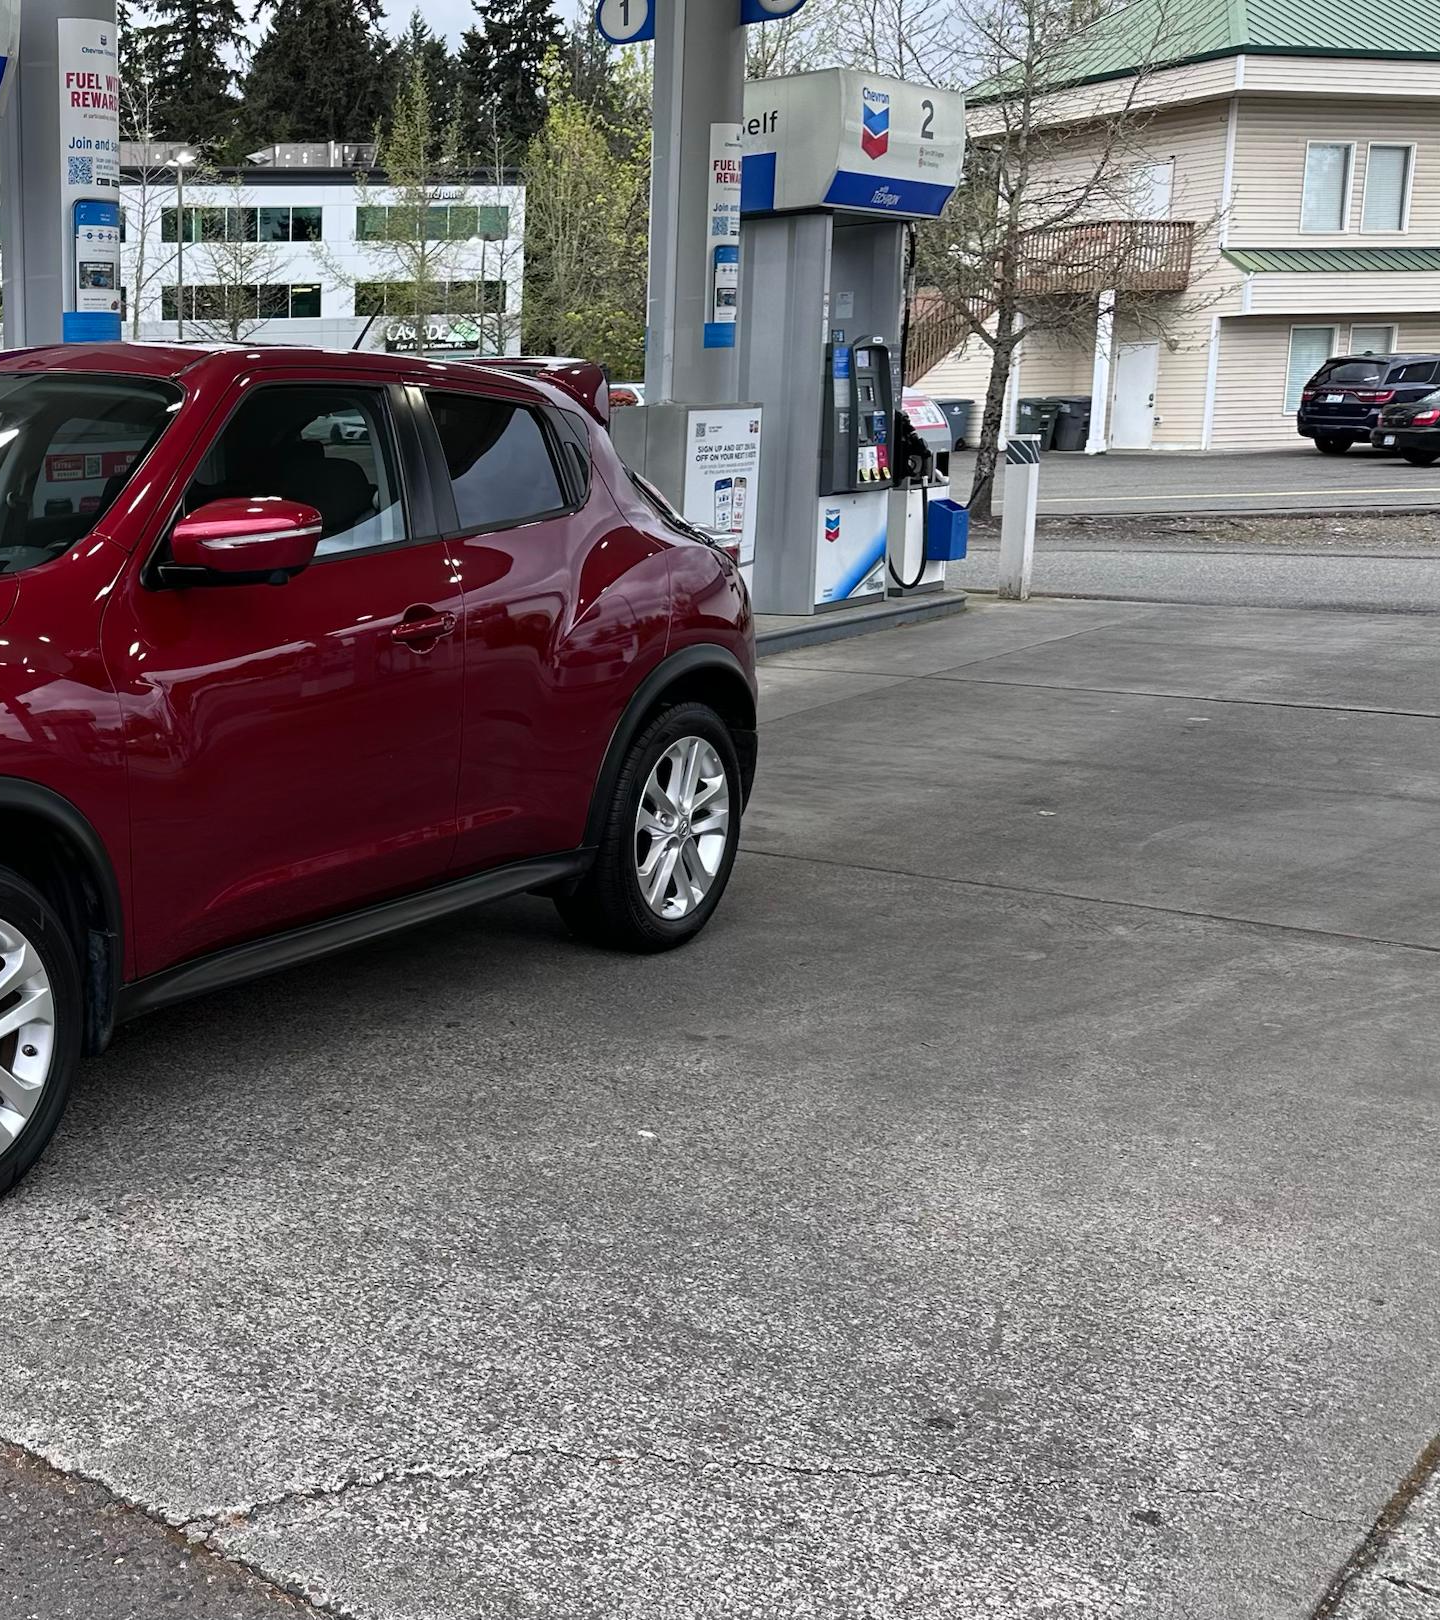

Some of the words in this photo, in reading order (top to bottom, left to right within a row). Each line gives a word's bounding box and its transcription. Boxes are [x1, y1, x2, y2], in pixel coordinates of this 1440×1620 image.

[619, 0, 629, 26] 1
[66, 72, 102, 90] FUEL
[863, 87, 889, 105] Chevron
[742, 110, 779, 135] elf
[921, 99, 934, 140] 2
[69, 136, 92, 149] Join
[95, 139, 110, 151] and
[713, 160, 737, 171] FUEL
